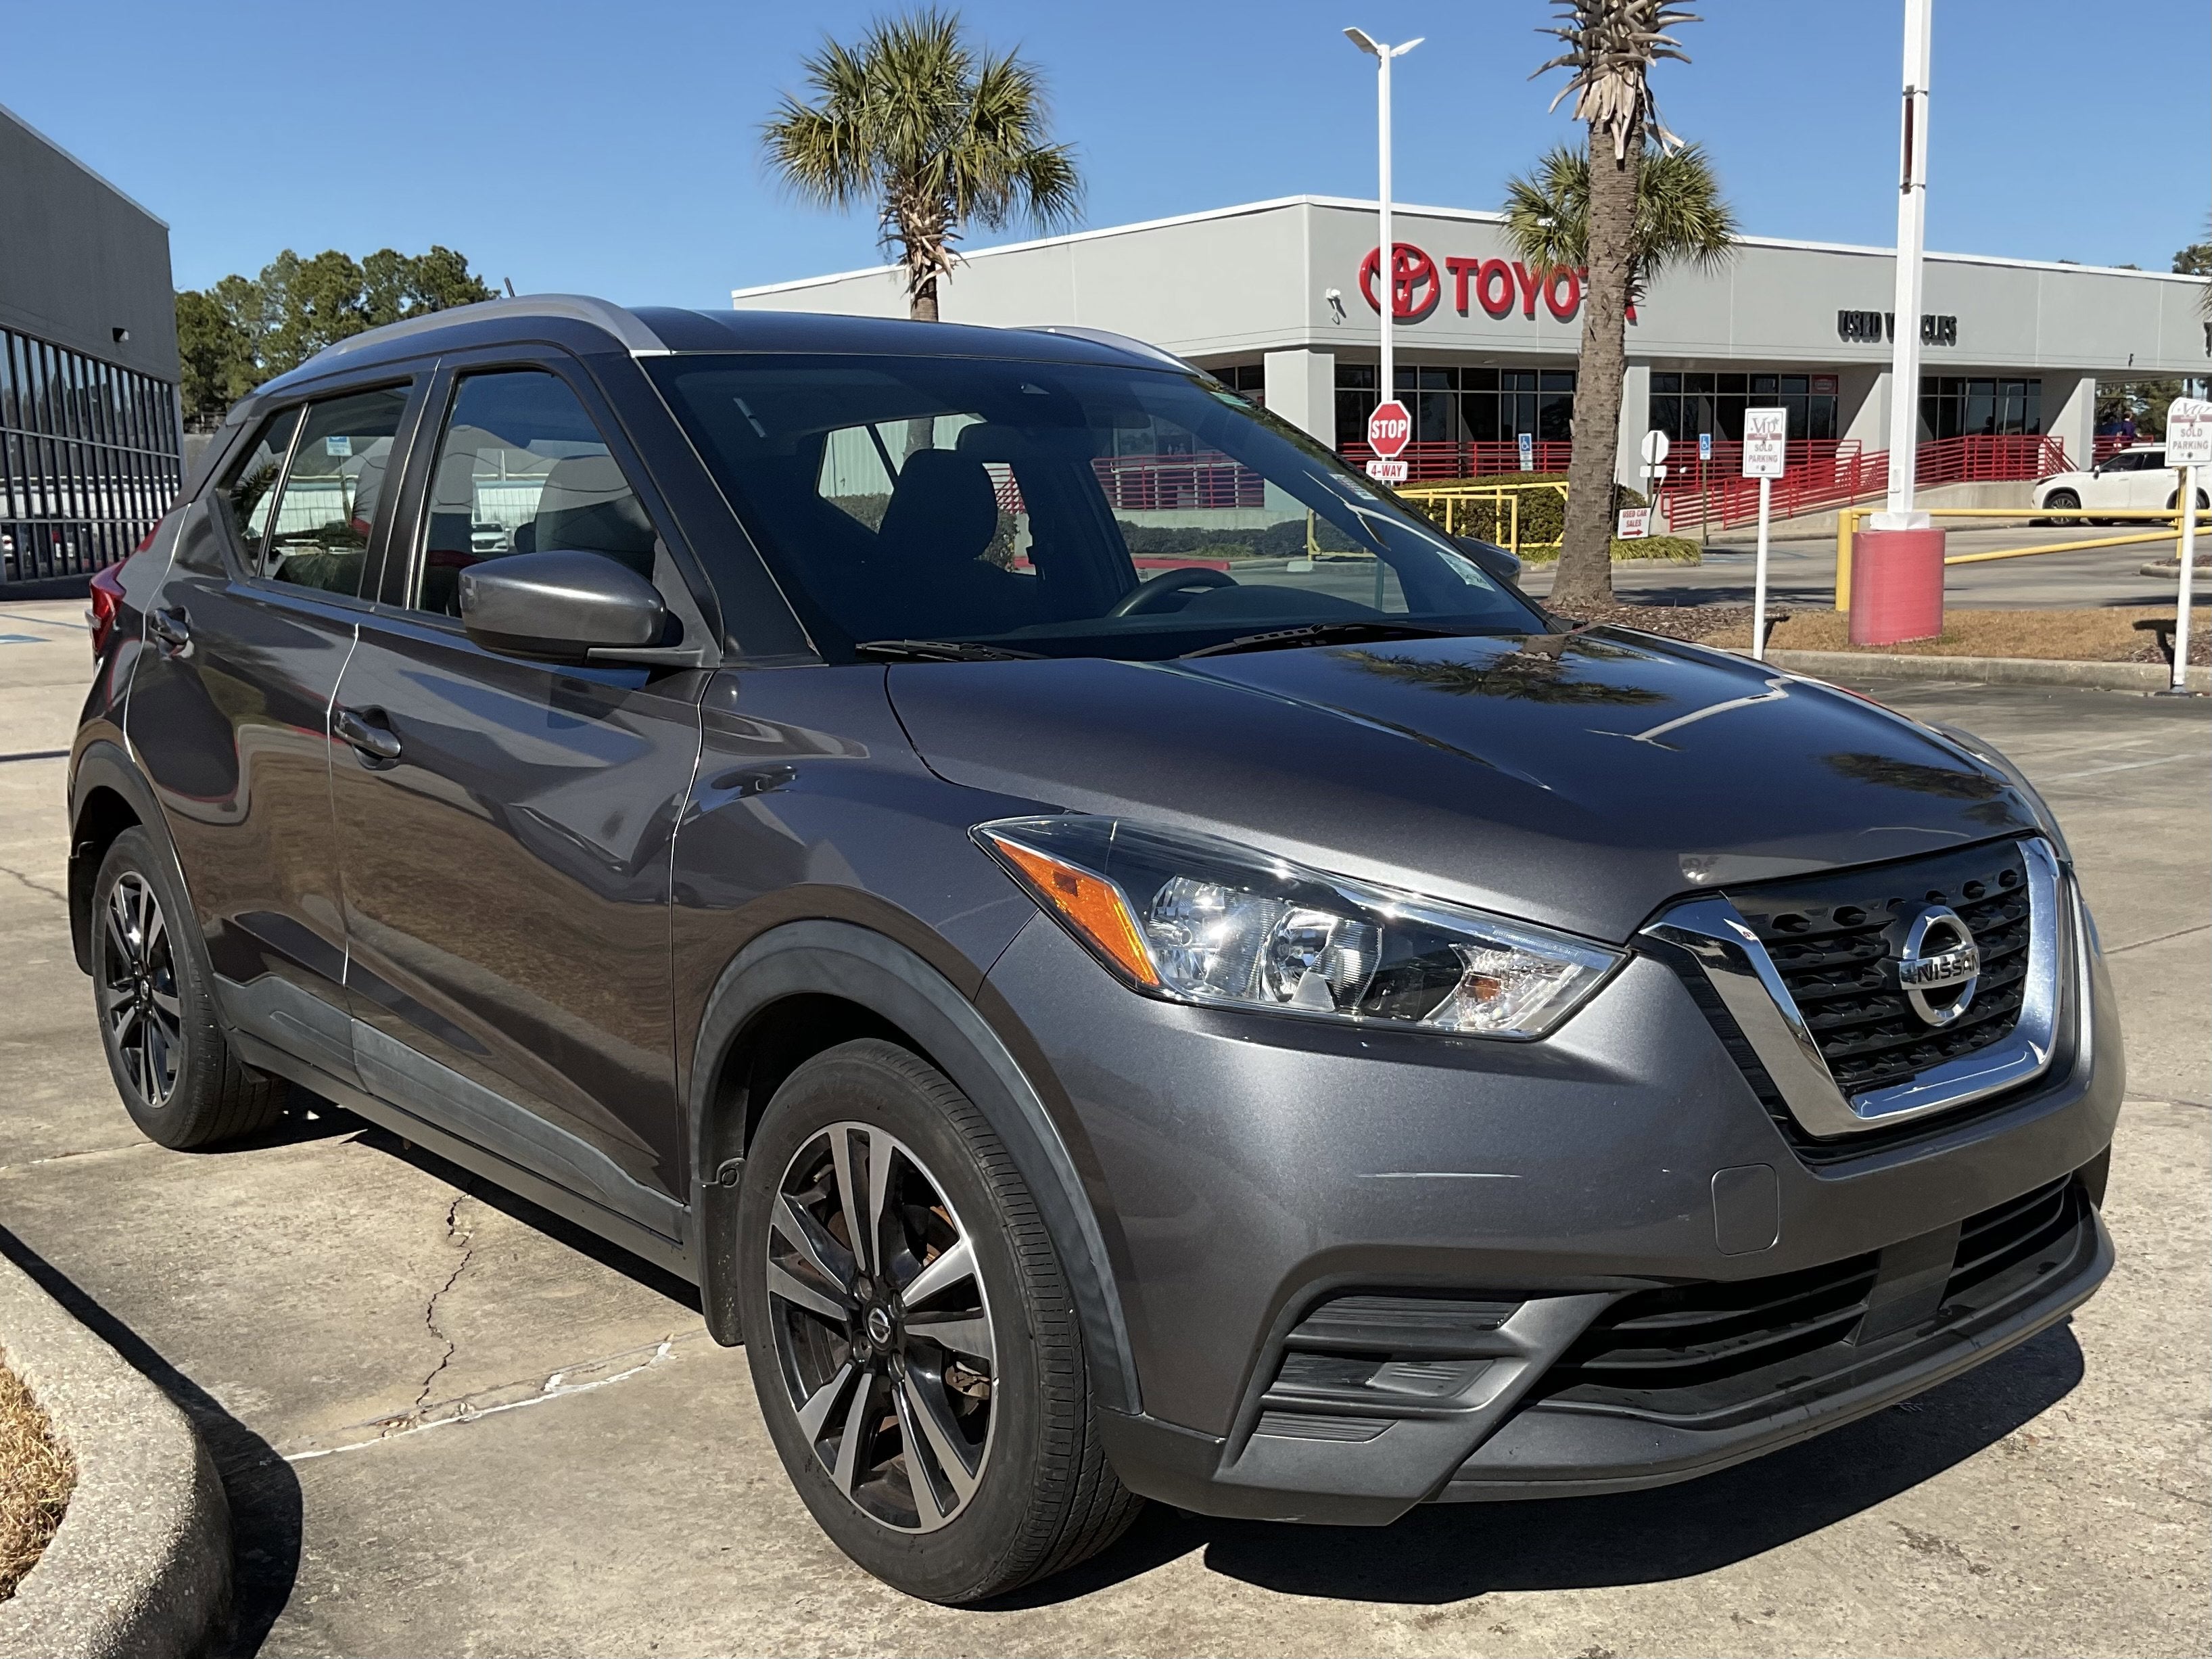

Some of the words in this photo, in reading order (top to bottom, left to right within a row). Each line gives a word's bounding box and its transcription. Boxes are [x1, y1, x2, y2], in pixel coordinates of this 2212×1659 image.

[1445, 256, 1637, 321] TOYO
[1837, 310, 1882, 341] USED
[1885, 312, 1957, 345] VCLES
[1371, 419, 1407, 439] STOP
[2180, 428, 2203, 437] SOLD
[1754, 444, 1773, 452] SOLD
[2173, 441, 2209, 449] PARKING
[1749, 454, 1778, 463] PARKING
[1371, 465, 1403, 477] 4-WAY
[1622, 510, 1636, 518] USED
[1626, 519, 1641, 528] SALES
[1917, 954, 1979, 983] NISSAN
